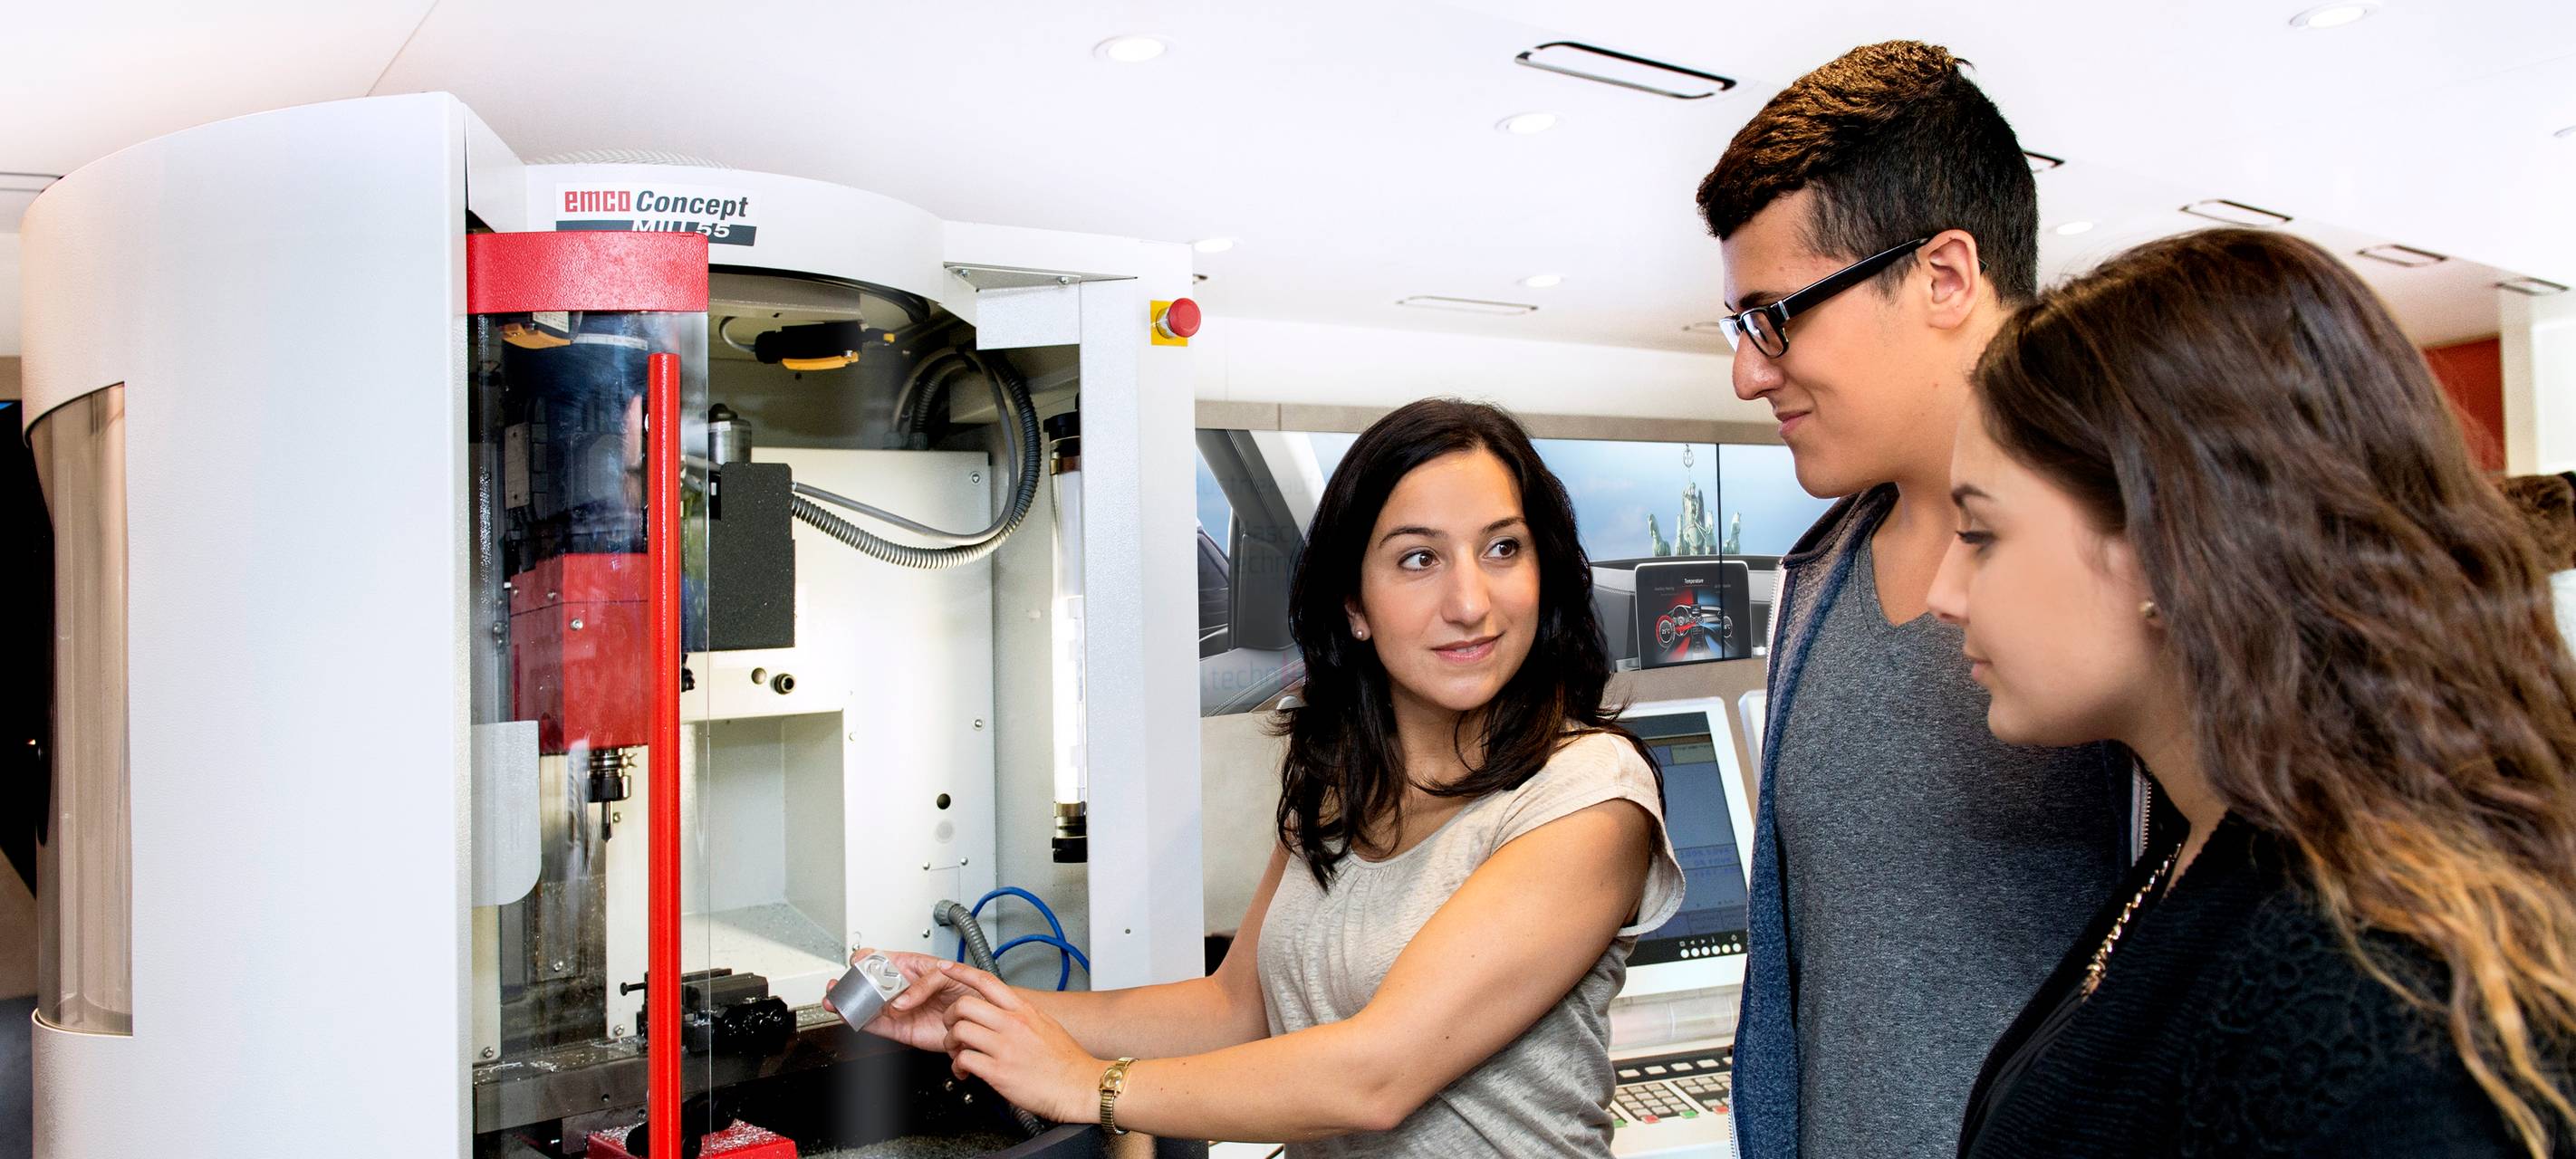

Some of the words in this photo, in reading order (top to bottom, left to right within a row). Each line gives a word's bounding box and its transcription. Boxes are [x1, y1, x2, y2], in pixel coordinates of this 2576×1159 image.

[564, 190, 631, 213] emco
[636, 190, 749, 220] Concept
[695, 223, 731, 238] 55
